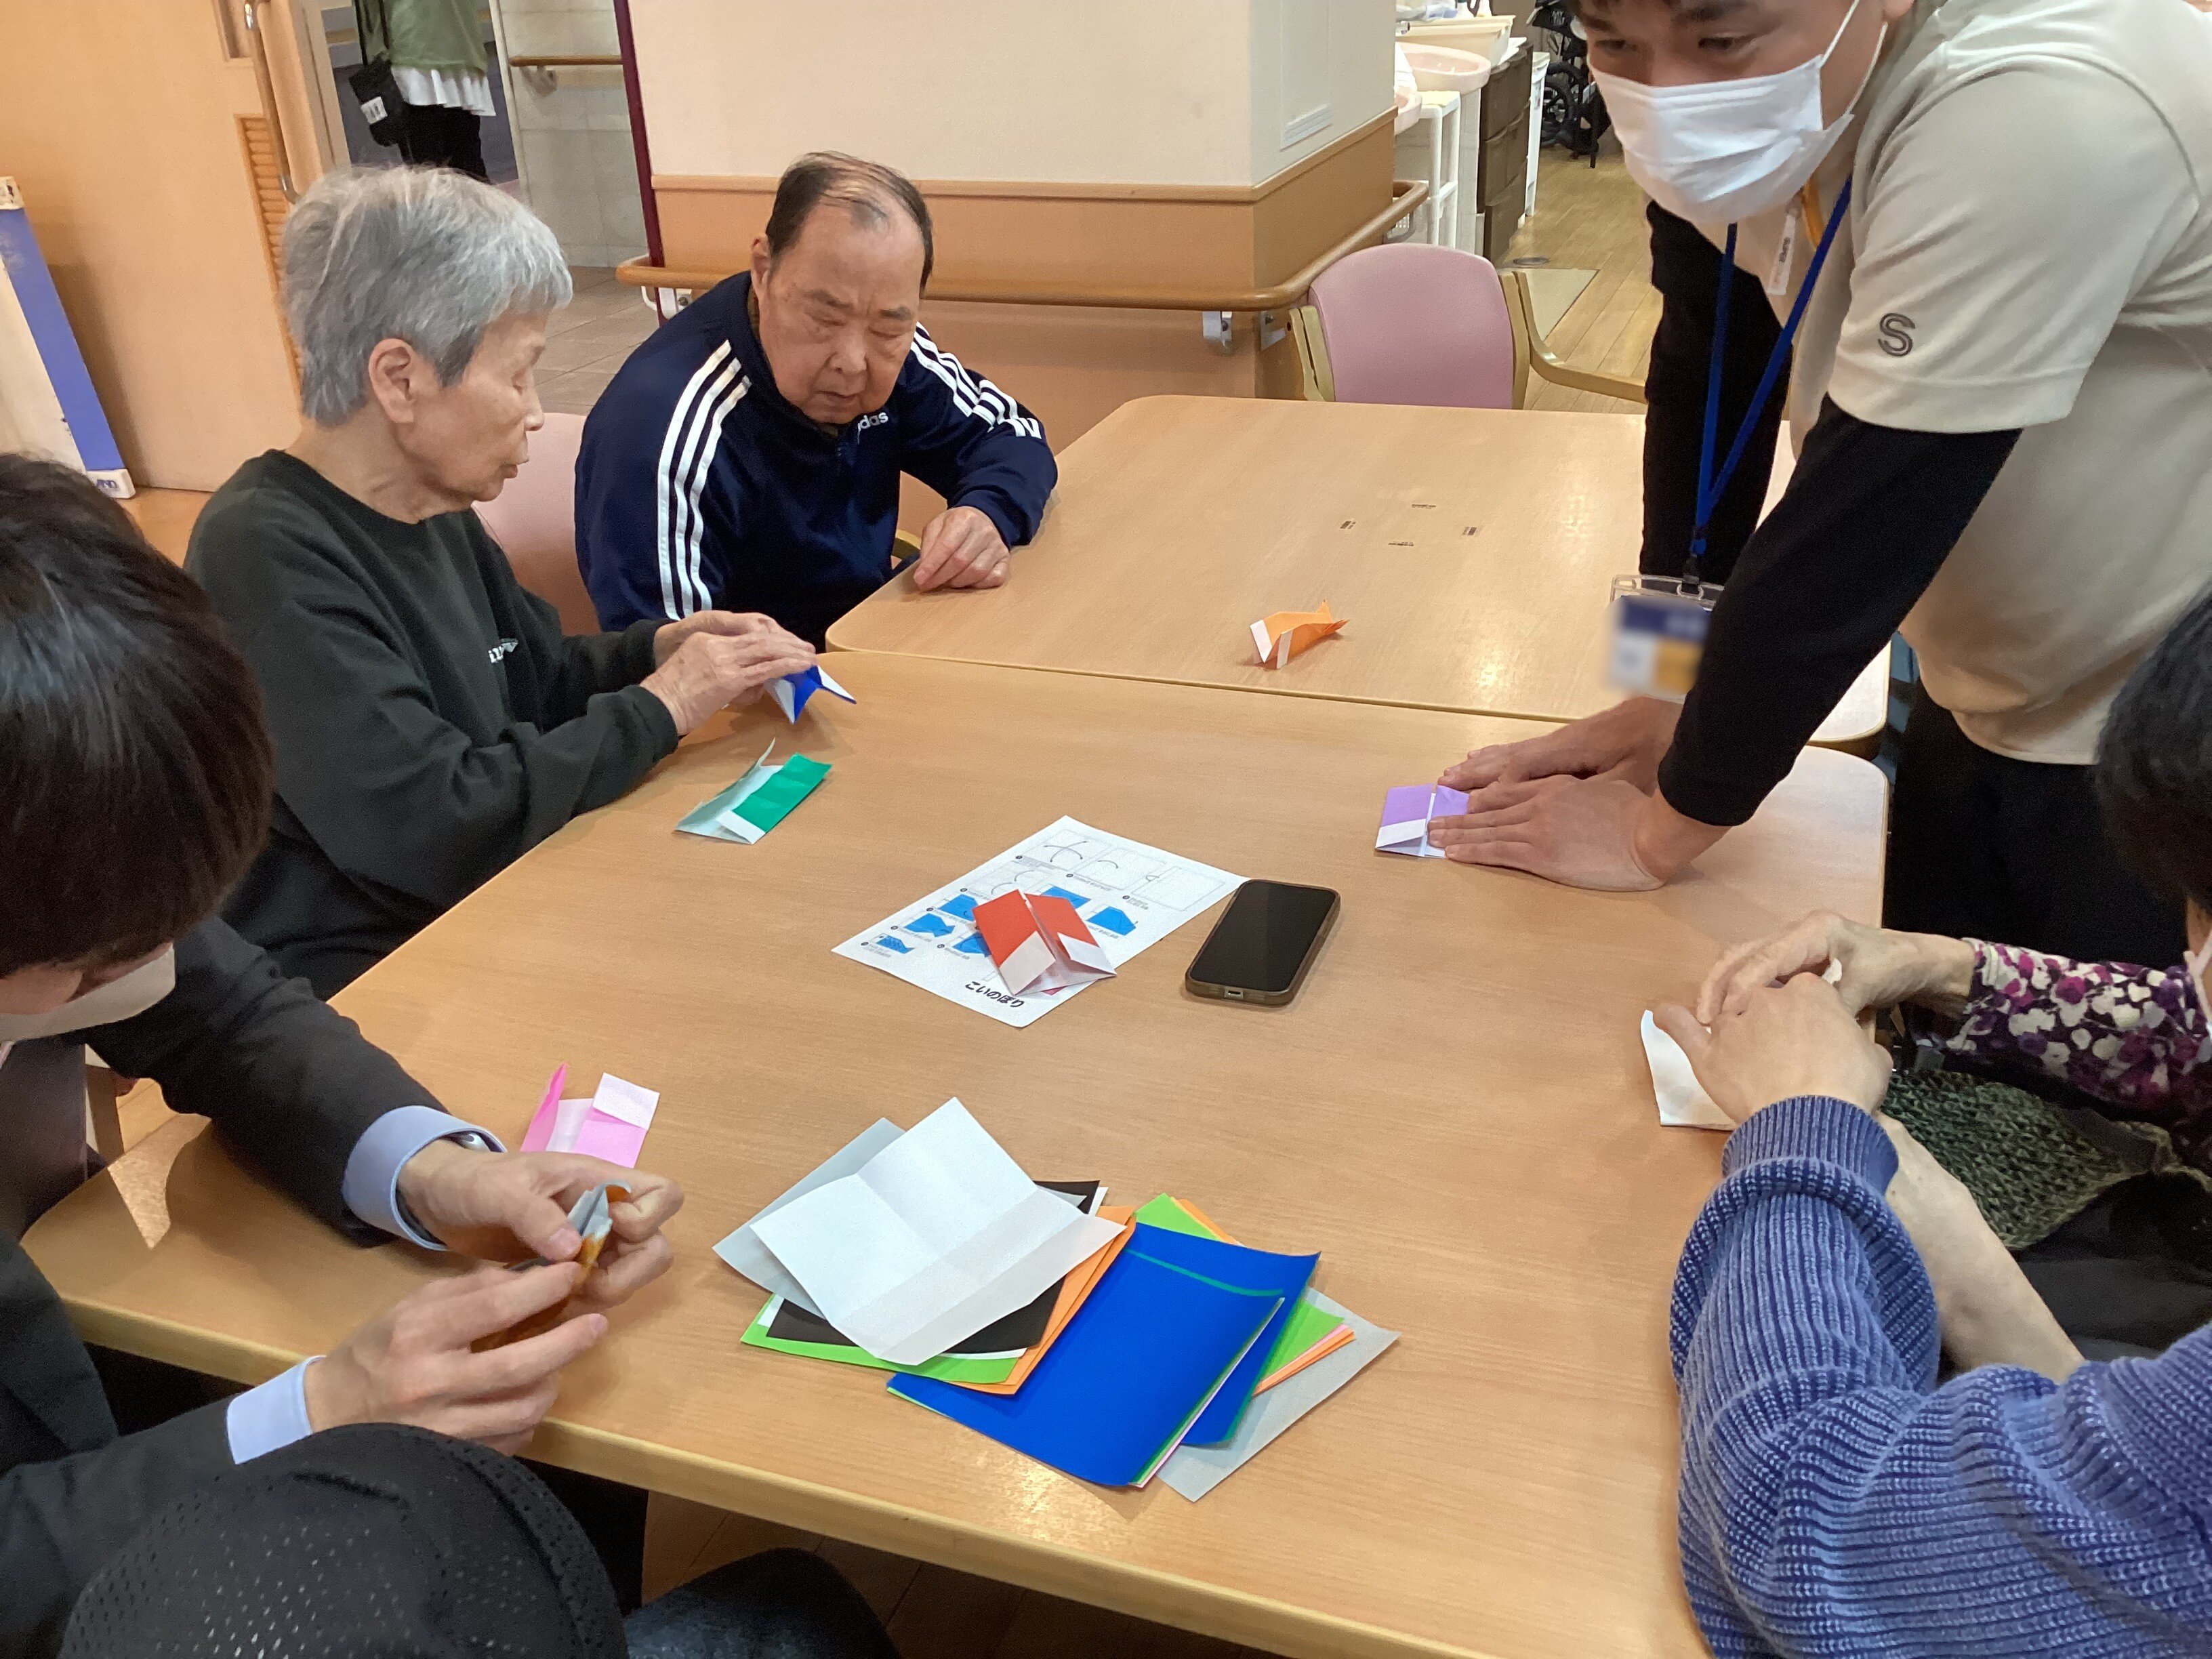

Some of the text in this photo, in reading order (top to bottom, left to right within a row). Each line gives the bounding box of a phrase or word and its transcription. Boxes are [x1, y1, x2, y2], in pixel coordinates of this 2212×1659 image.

[1878, 312, 1916, 357] S
[964, 981, 1025, 1008] こいのぼり
